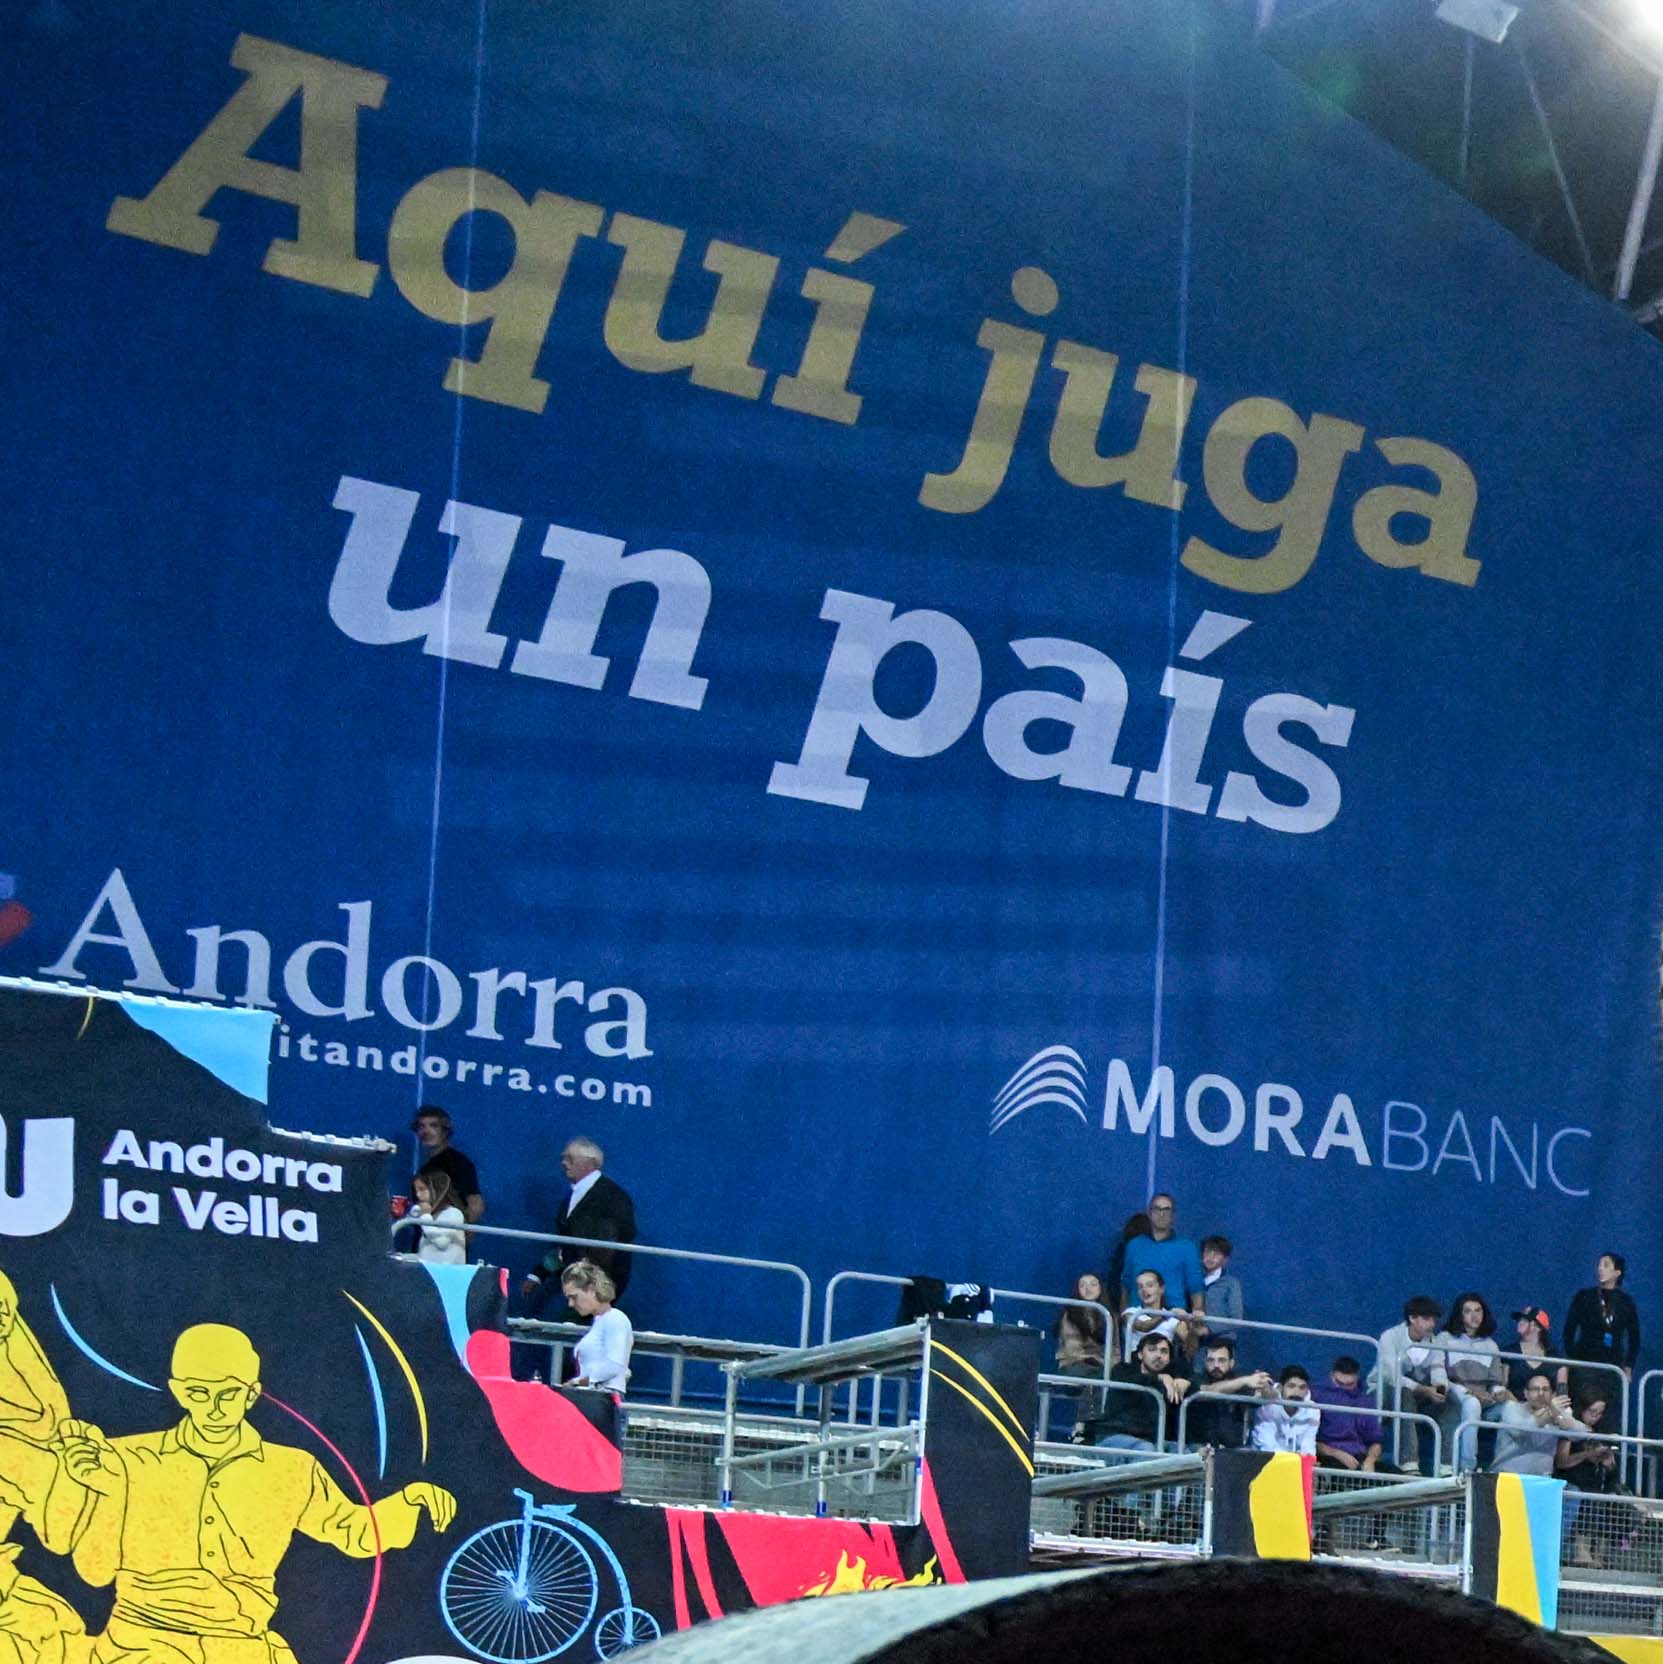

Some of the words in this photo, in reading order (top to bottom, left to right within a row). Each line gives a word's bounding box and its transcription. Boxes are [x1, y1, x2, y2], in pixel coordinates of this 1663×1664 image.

[106, 32, 908, 425] Aquí
[919, 266, 1482, 594] juga
[327, 475, 712, 711] un
[766, 612, 1357, 835] país
[39, 867, 655, 1060] Andorra
[279, 1024, 653, 1107] itandorra.com
[1102, 1058, 1592, 1196] MORABANC
[102, 1129, 342, 1192] Andorra
[103, 1178, 159, 1225] la
[172, 1187, 318, 1243] Vella
